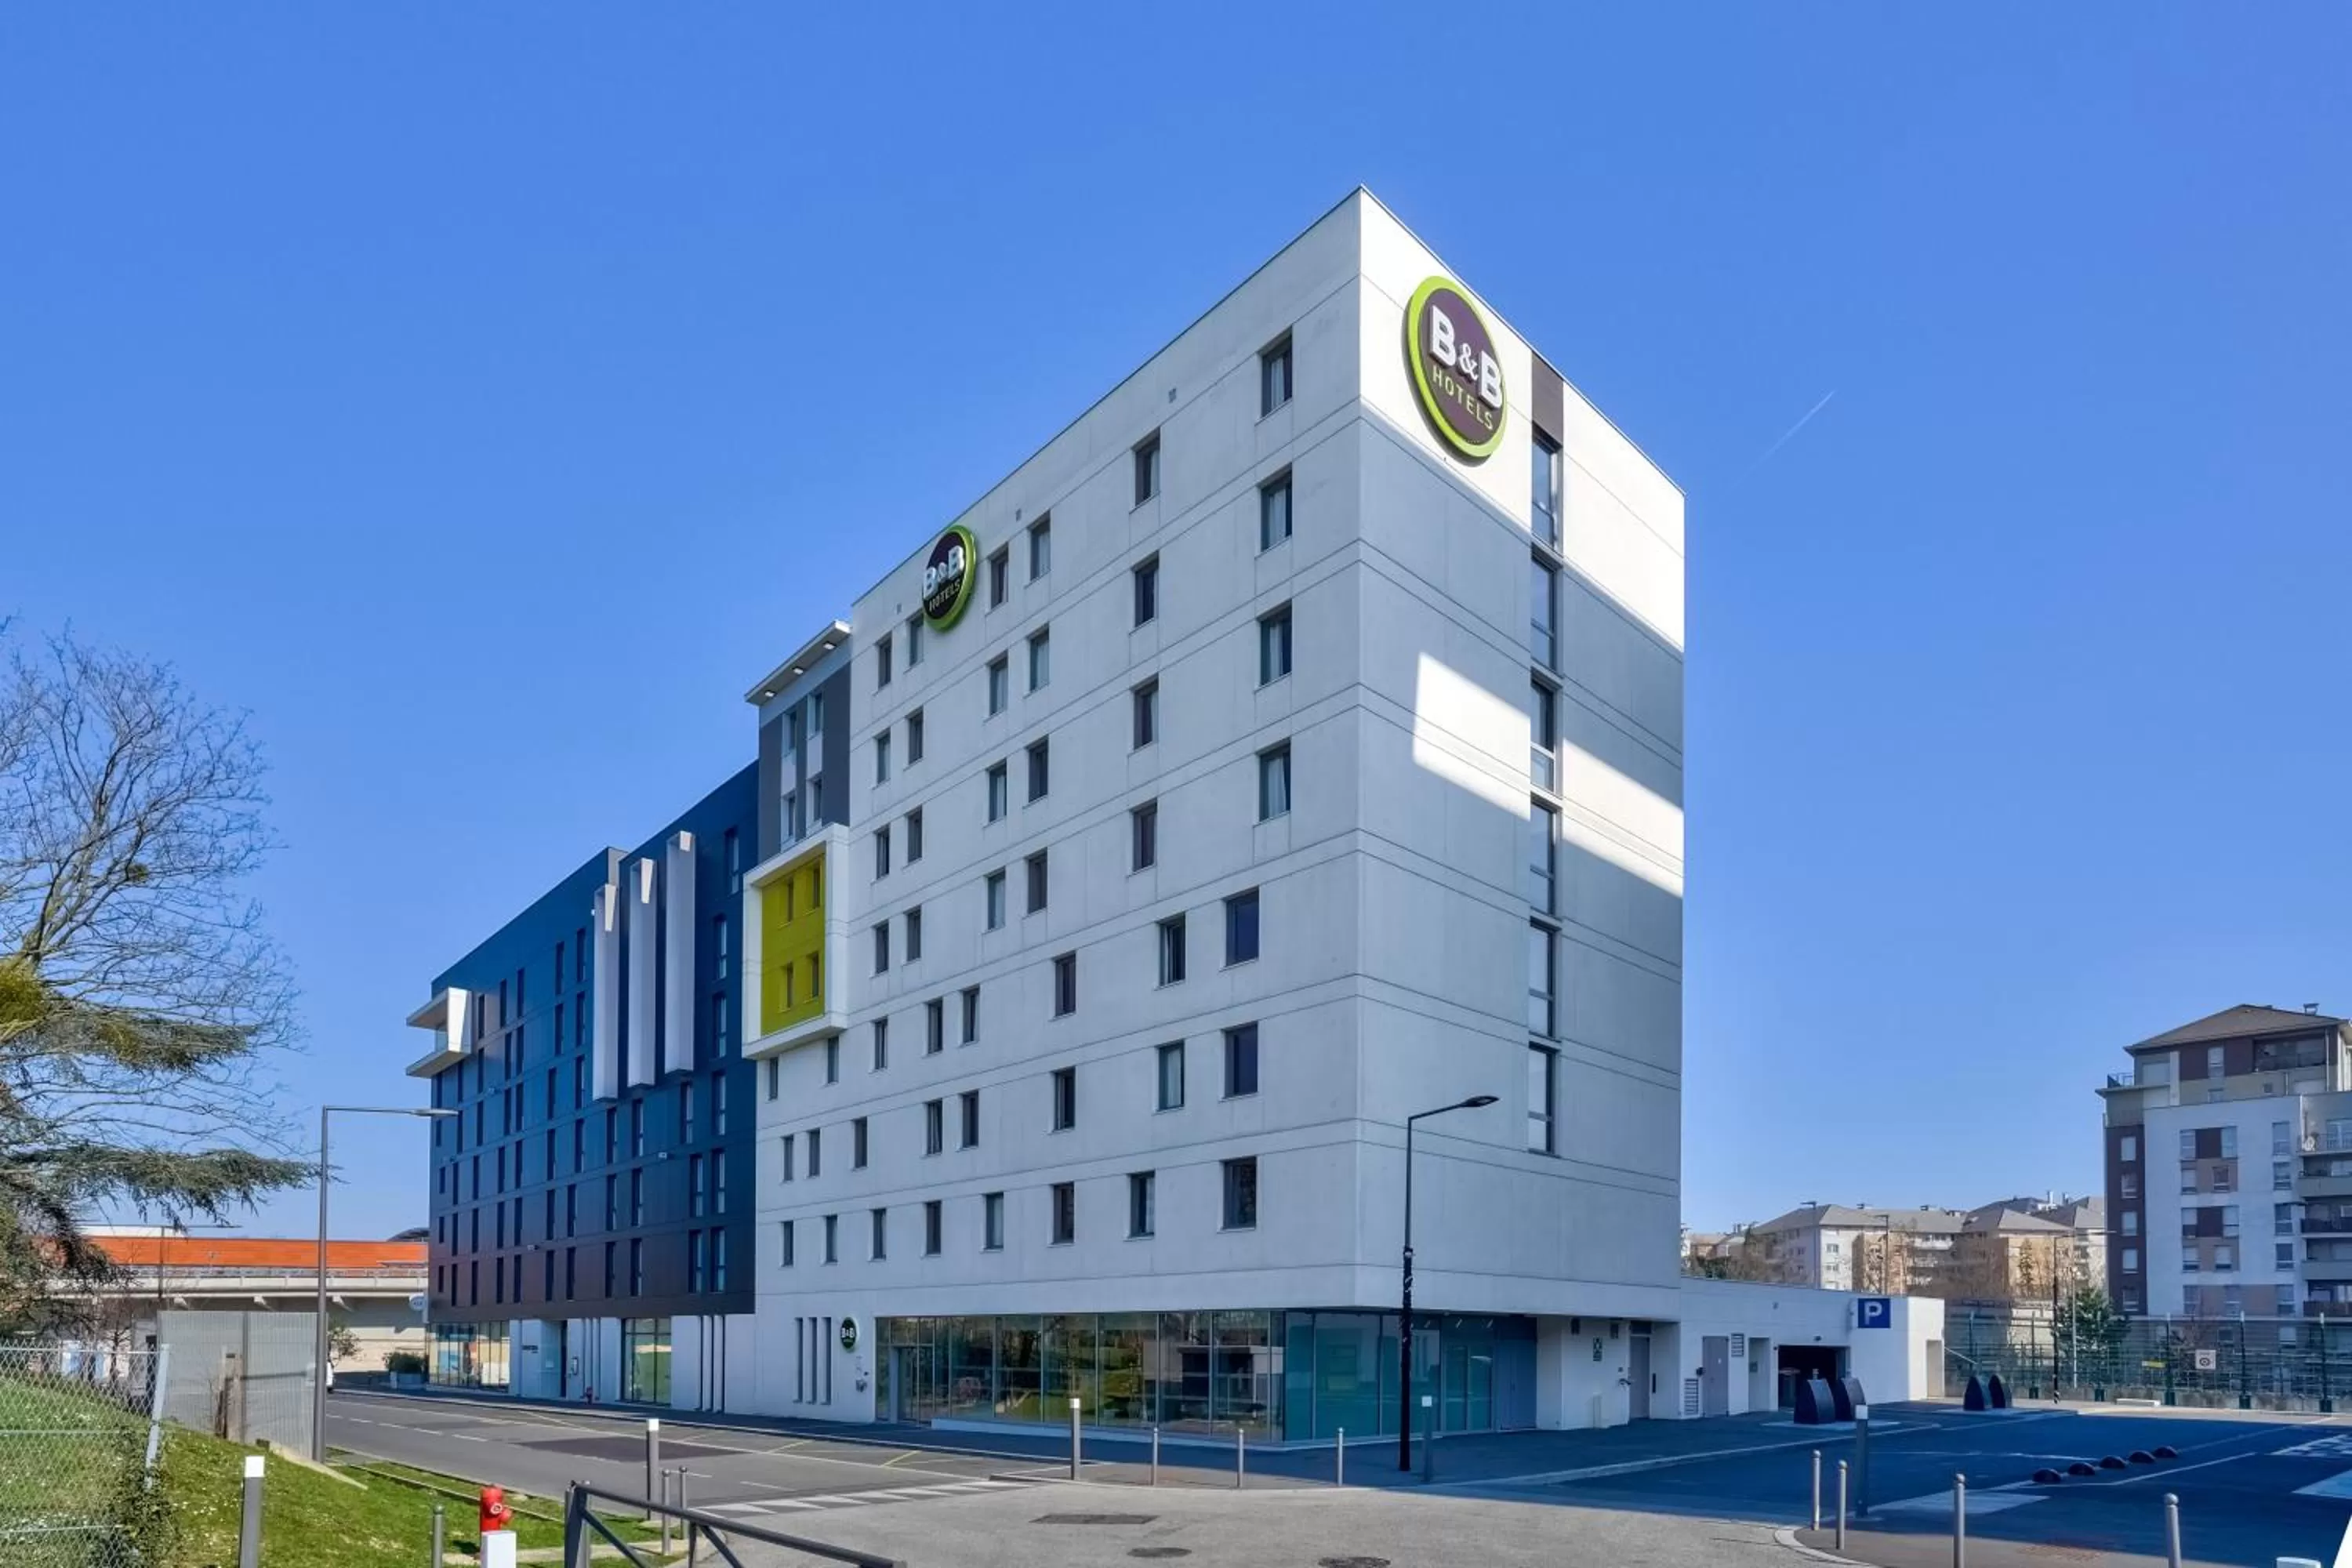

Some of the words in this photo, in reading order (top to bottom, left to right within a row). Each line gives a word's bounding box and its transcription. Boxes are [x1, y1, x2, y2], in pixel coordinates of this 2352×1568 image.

[1431, 305, 1503, 409] B&B
[1432, 365, 1494, 430] HOTELS
[924, 545, 965, 601] B&B
[929, 579, 960, 612] HOTELS
[1864, 1301, 1882, 1325] P
